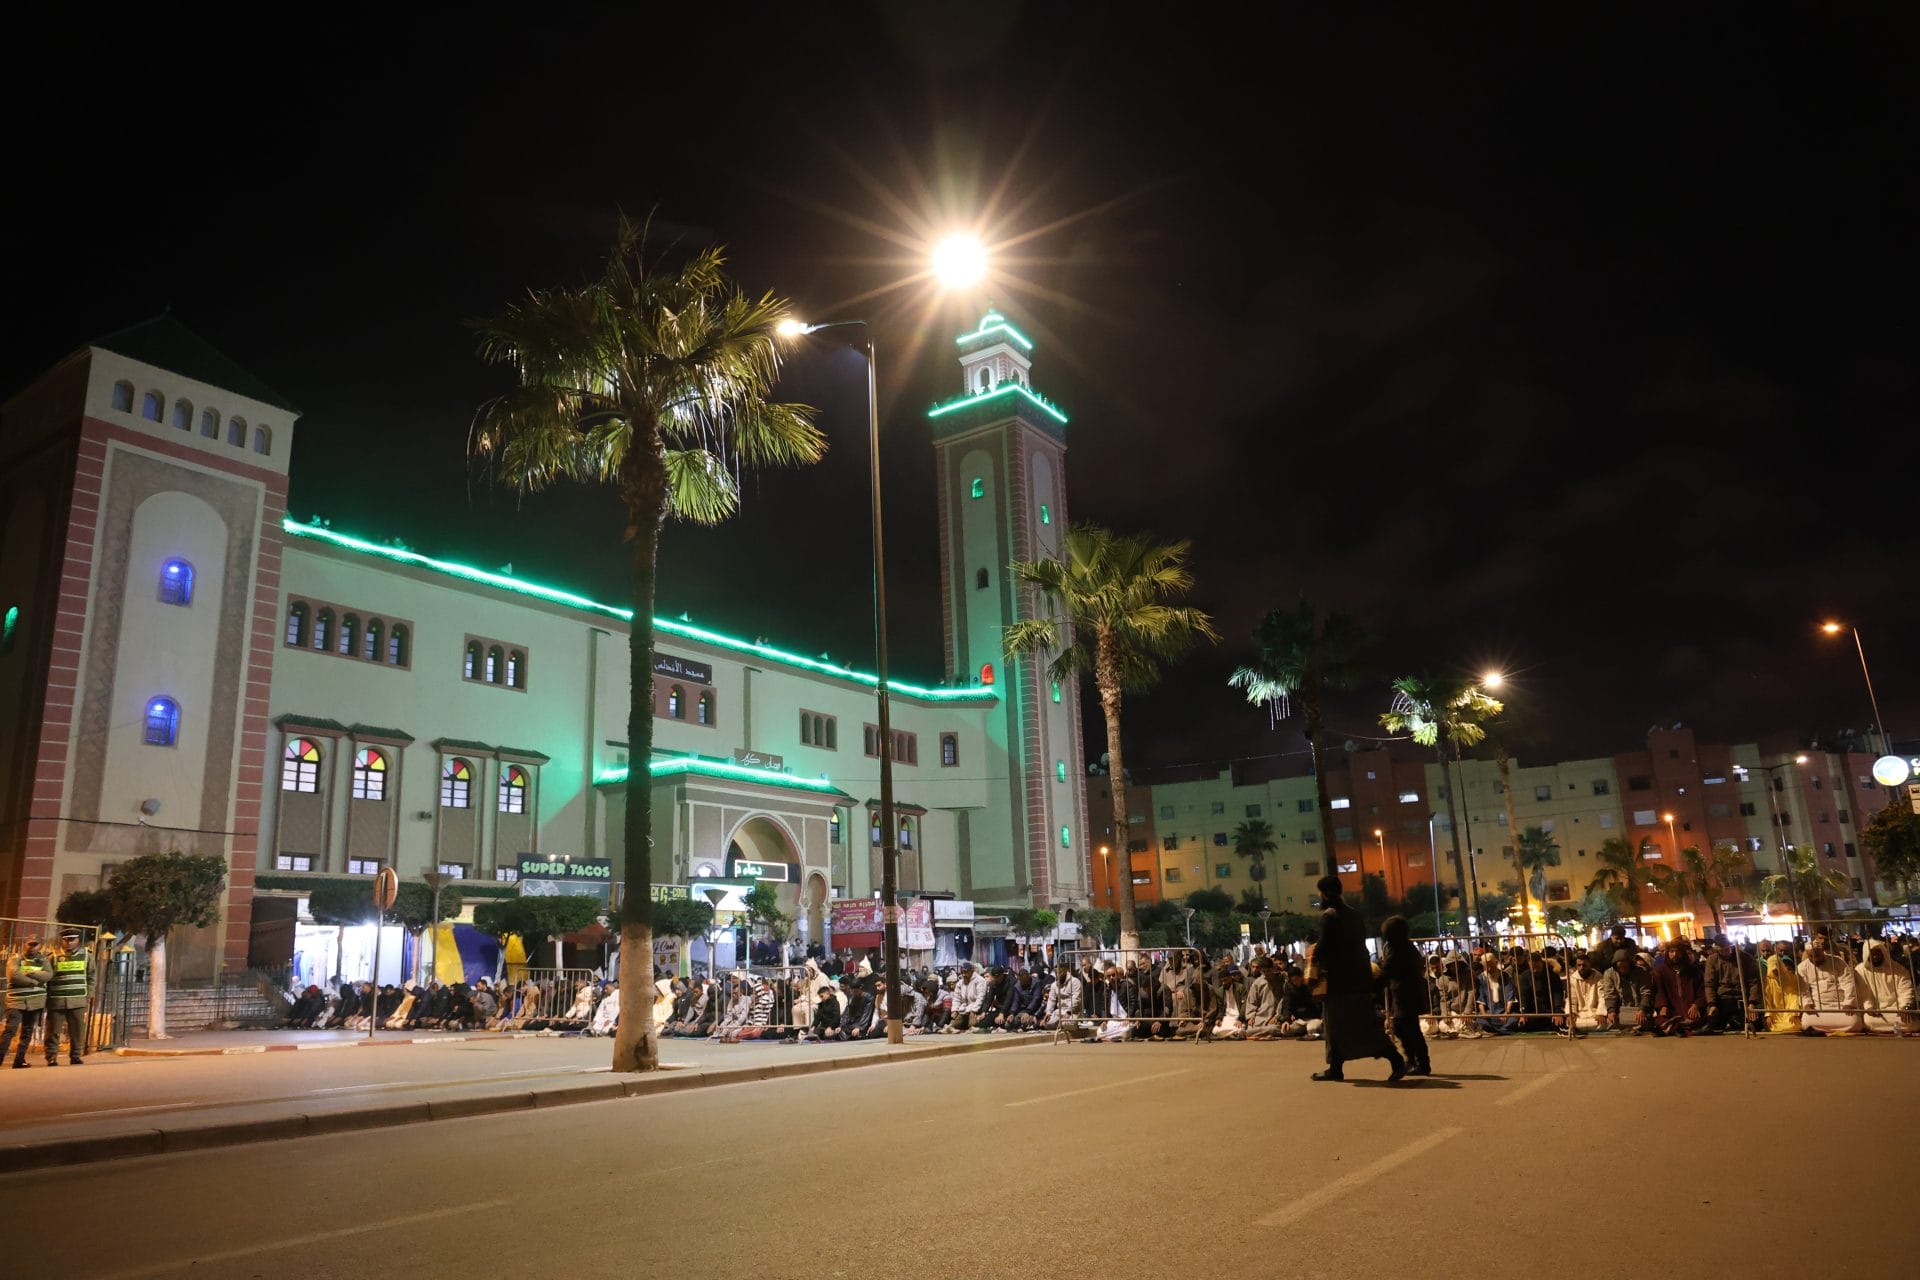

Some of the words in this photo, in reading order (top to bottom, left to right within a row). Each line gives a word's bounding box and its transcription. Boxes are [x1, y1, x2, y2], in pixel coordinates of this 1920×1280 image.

[654, 659, 683, 673] الأندلس
[685, 667, 705, 678] مسجد
[522, 861, 566, 876] SUPER
[569, 863, 610, 878] TACOS
